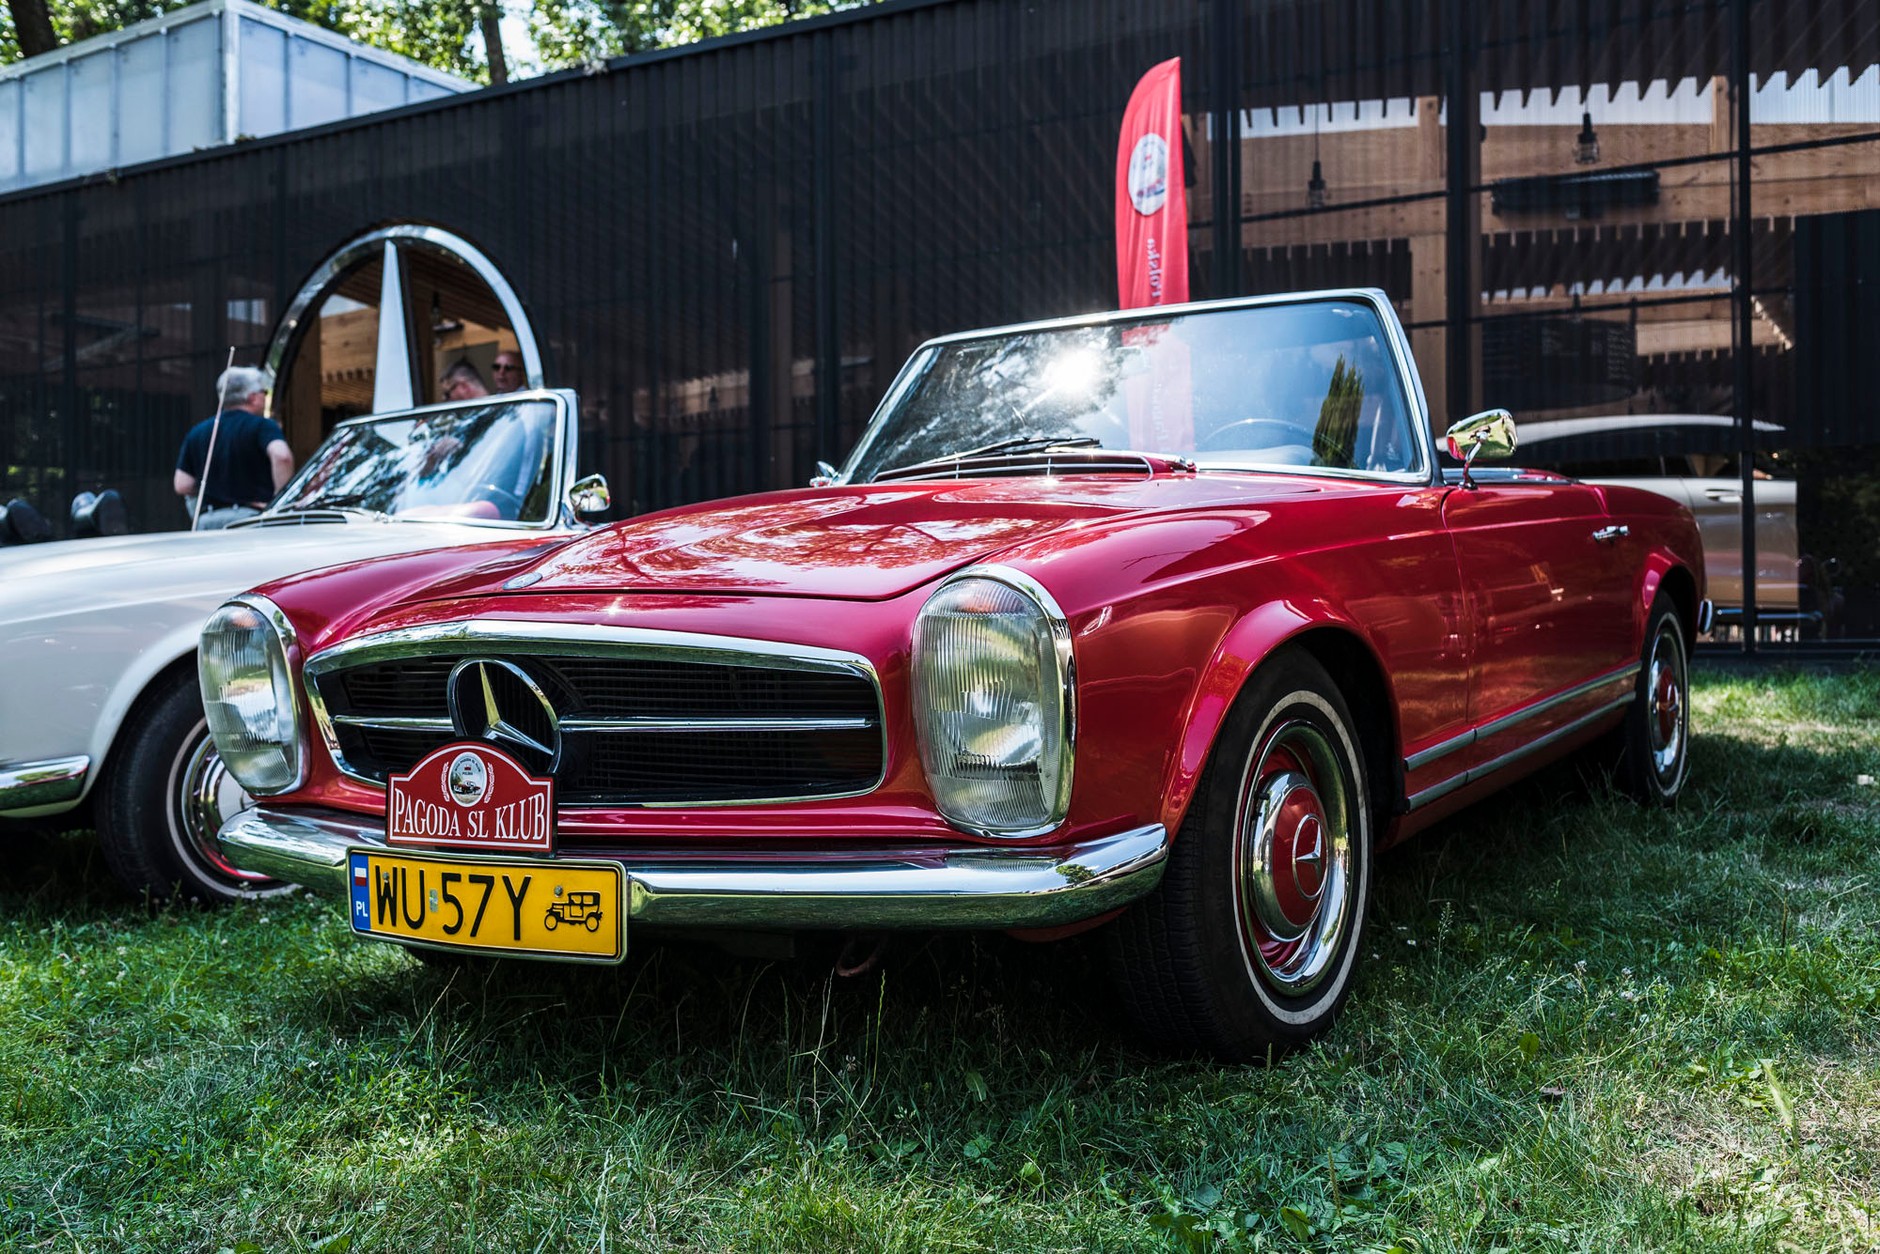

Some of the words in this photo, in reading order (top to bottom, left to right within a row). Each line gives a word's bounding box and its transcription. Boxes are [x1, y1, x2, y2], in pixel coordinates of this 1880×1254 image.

[394, 788, 461, 837] PAGODA
[467, 810, 489, 839] SL
[495, 792, 545, 840] KLUB
[355, 900, 369, 917] PL
[375, 865, 425, 930] WU
[441, 872, 532, 941] 57Y
